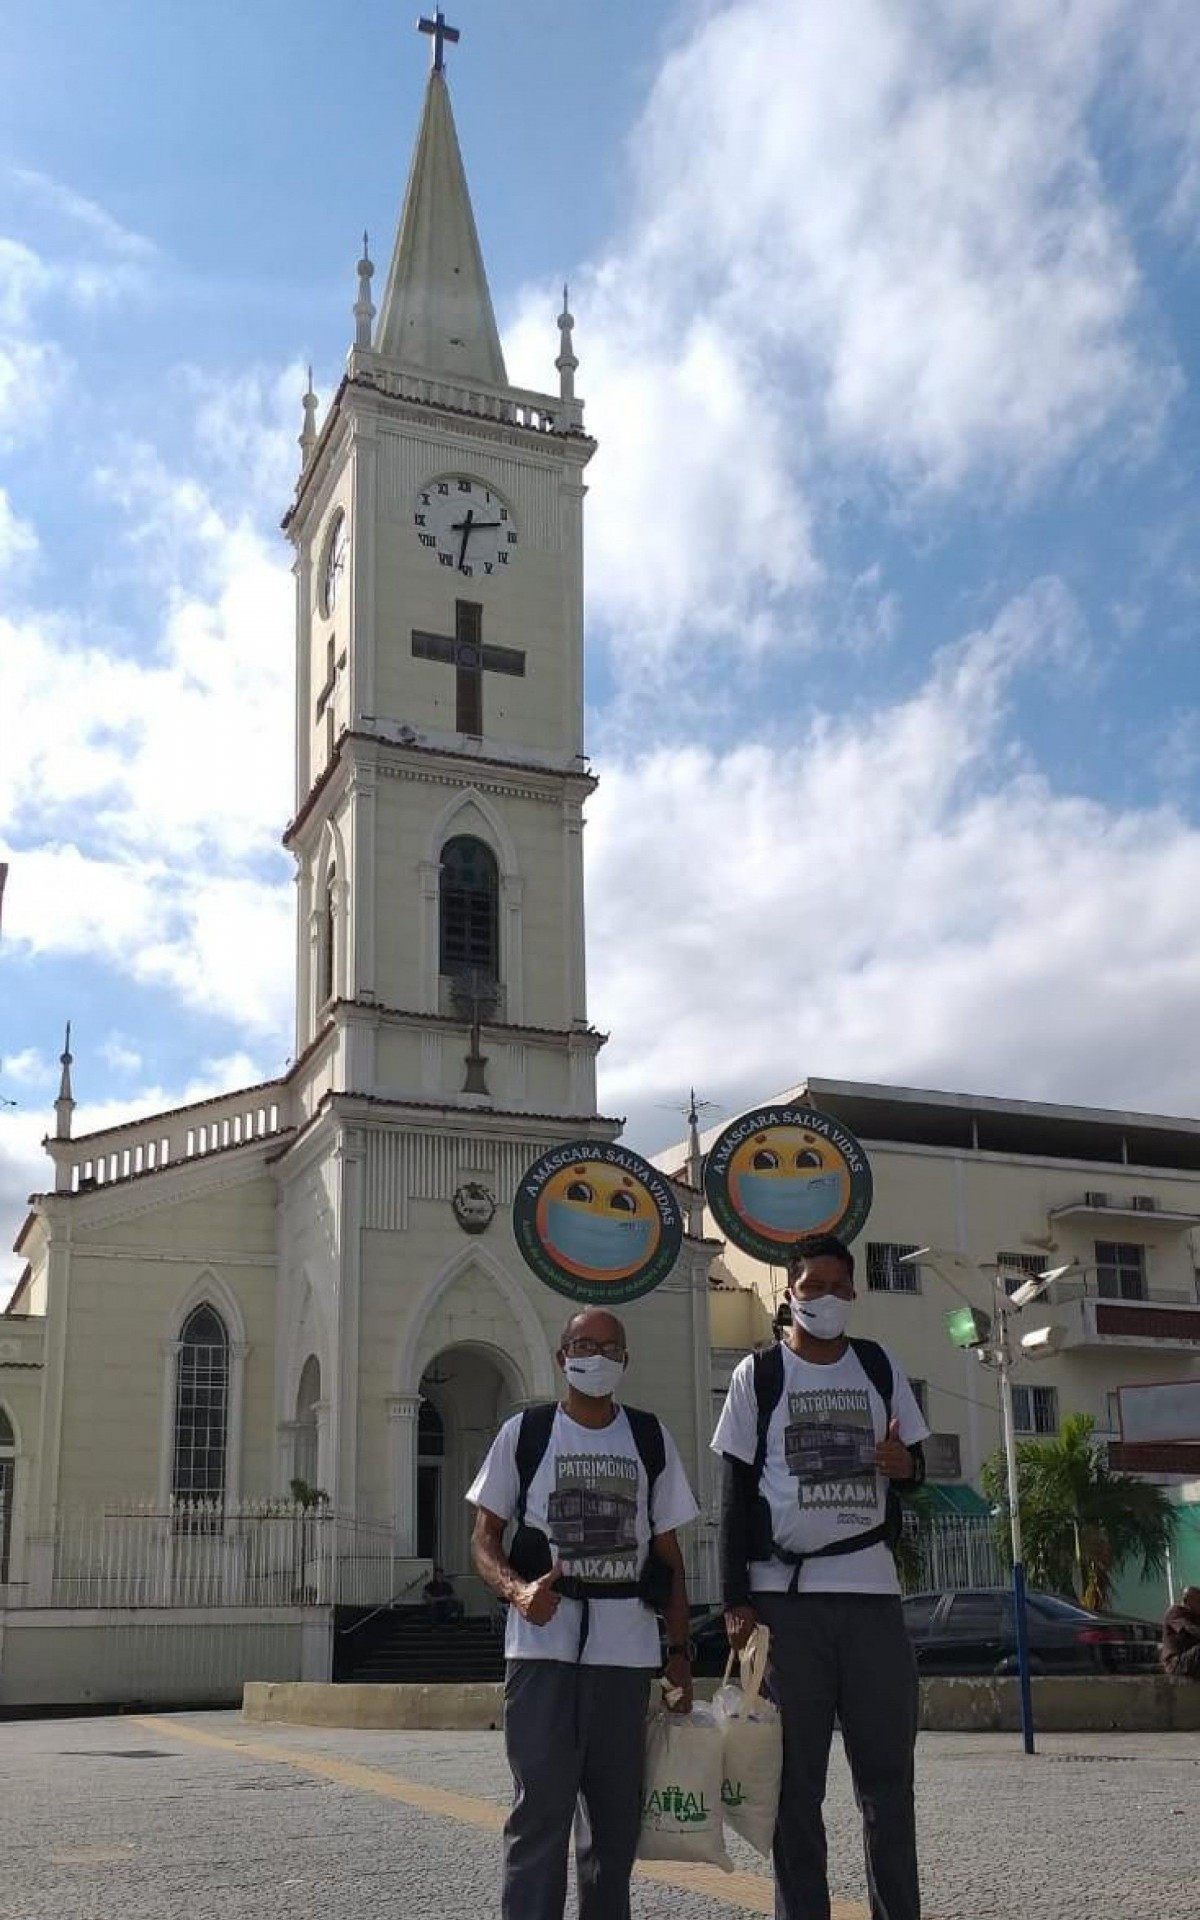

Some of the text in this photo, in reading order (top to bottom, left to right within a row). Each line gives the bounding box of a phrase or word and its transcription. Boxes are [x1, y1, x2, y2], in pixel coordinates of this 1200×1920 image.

[782, 1111, 830, 1136] SALVA
[832, 1131, 864, 1174] VIDAS
[525, 1186, 539, 1199] A
[606, 1150, 650, 1184] SALVA
[651, 1179, 675, 1227] VIDAS
